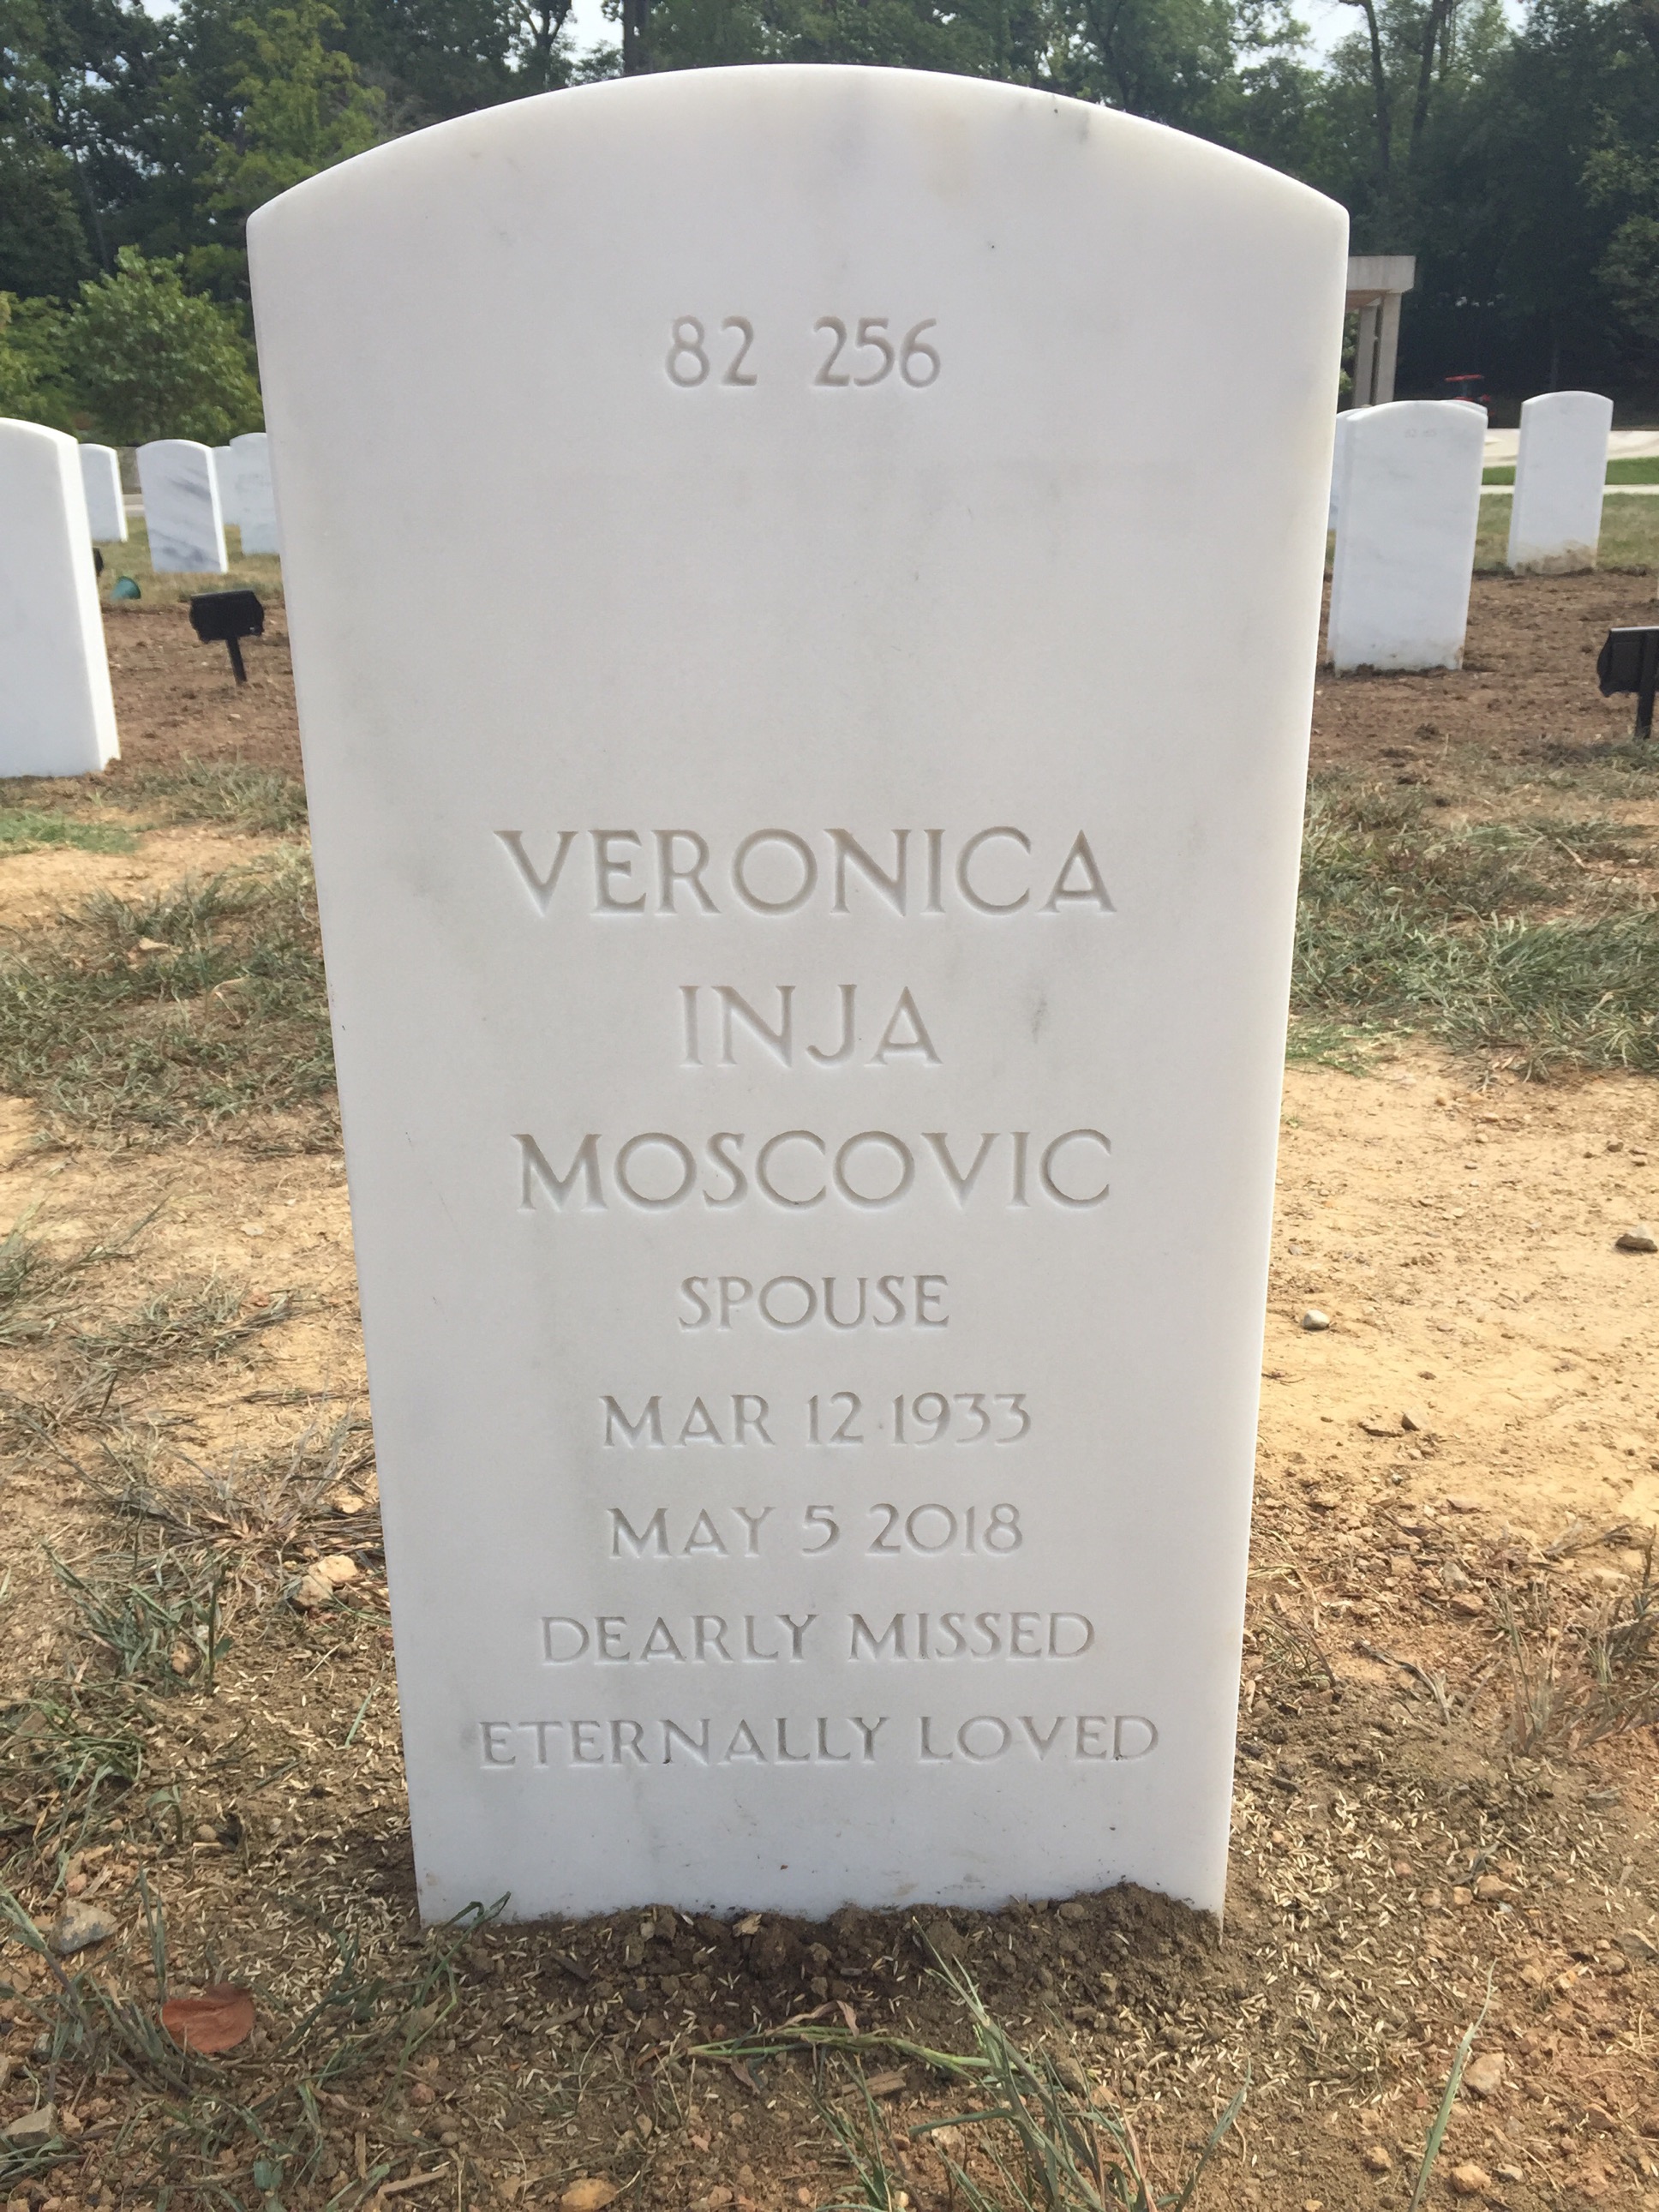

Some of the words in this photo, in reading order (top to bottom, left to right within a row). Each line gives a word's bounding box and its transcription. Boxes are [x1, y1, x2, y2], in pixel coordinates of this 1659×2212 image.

[665, 315, 758, 387] 82
[813, 315, 941, 387] 256
[494, 826, 1117, 917] VERONICA
[678, 984, 943, 1068] INJA
[512, 1129, 1111, 1211] MOSCOVIC
[678, 1274, 949, 1330] SPOUSE
[601, 1394, 775, 1447] MAR
[805, 1392, 864, 1445] 12
[890, 1392, 1031, 1446] 1933
[608, 1506, 776, 1558] MAY
[802, 1505, 841, 1555] 5
[864, 1503, 1024, 1556] 2018
[541, 1614, 820, 1665] DEARLY
[847, 1611, 1096, 1662] MISSED
[479, 1716, 889, 1769] ETERNALLY
[915, 1715, 1160, 1764] LOVED
